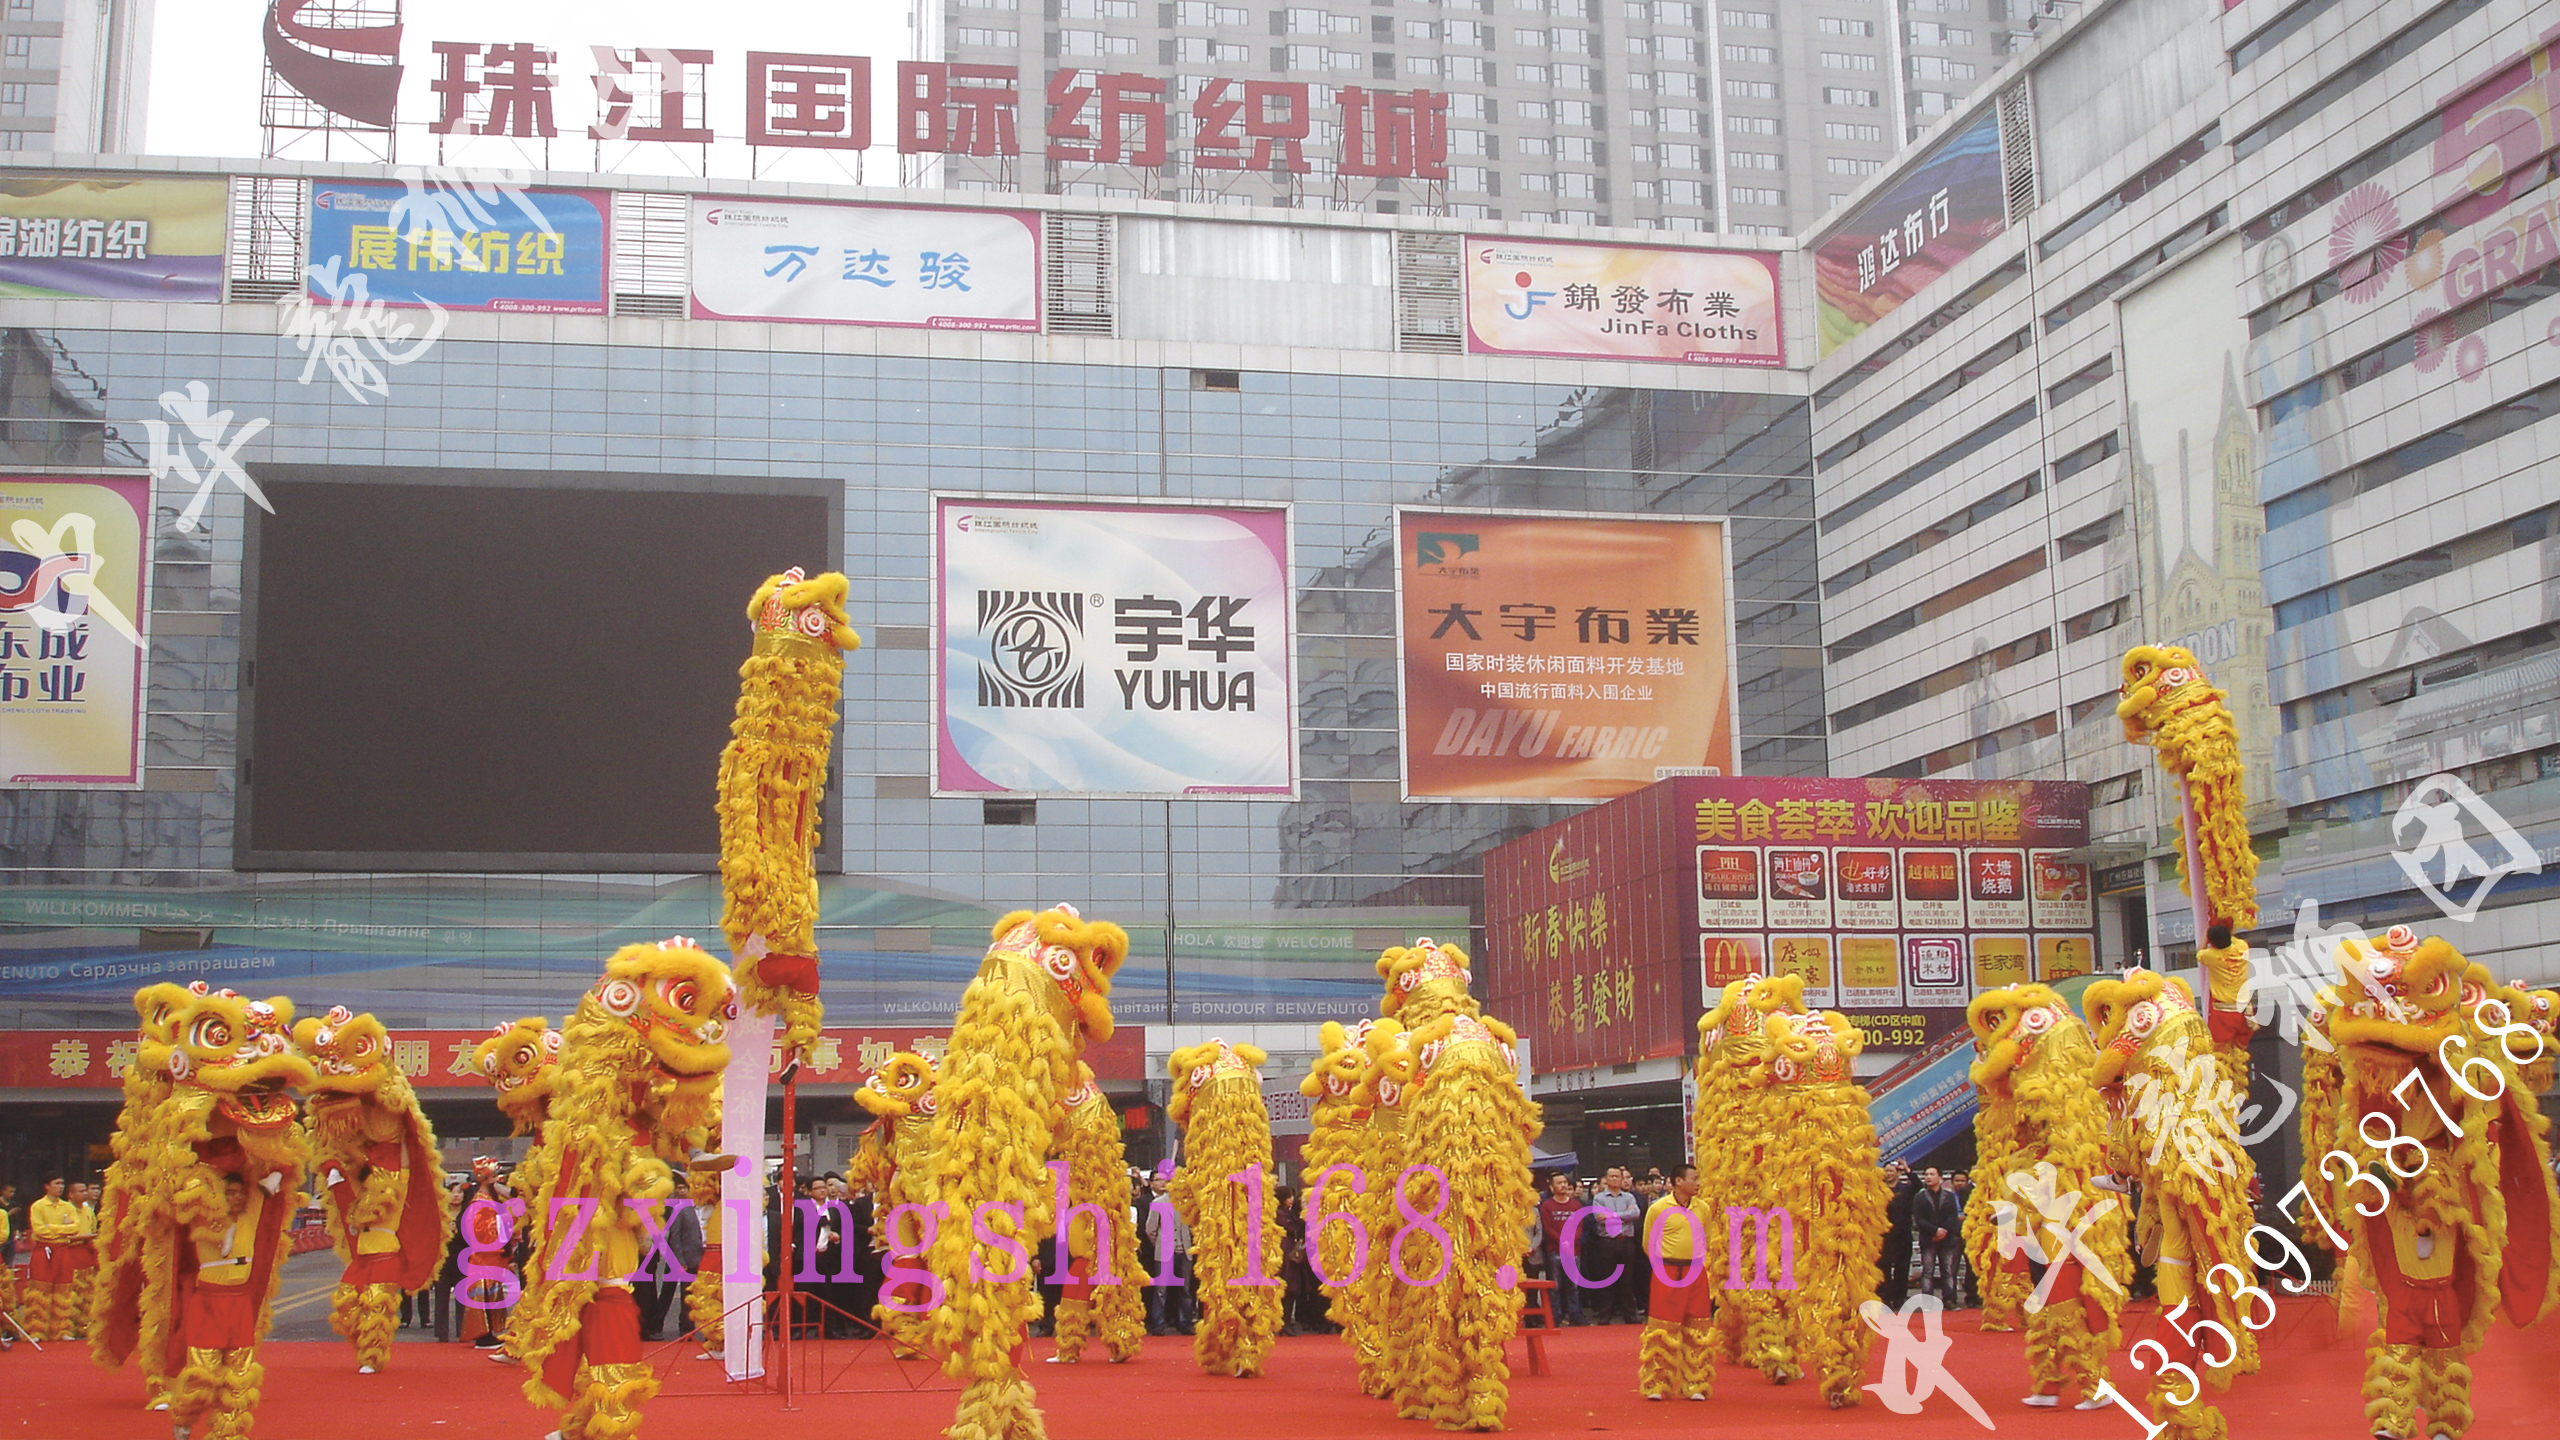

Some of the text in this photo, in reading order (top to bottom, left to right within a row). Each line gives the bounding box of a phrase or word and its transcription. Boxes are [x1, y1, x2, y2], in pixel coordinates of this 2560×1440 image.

[429, 39, 1448, 180] 珠江国际纺织城
[349, 224, 564, 276] 展伟纺织
[1857, 187, 1949, 294] 鸿达布行
[764, 245, 972, 292] 万达骏
[1562, 282, 1741, 319] 錦發布業
[1600, 319, 1759, 341] JinFa Cloths
[1114, 594, 1256, 663] 宇华
[1428, 602, 1700, 647] 大宇布業
[1445, 652, 1685, 678] 国家时装休闲面料开发基地
[0, 664, 86, 703] 布业
[1114, 668, 1255, 712] YUHUA
[1480, 681, 1654, 702] 中国流行面料入围企业
[1433, 708, 1670, 760] DAYU FABRIC
[1695, 798, 2021, 843] 美食荟萃 欢迎品鉴
[1981, 859, 2012, 876] 大塘
[24, 901, 157, 917] WILLKOMMEN
[1174, 932, 1215, 947] HOLA
[1276, 936, 1353, 949] WELCOME
[0, 965, 60, 980] ENUTO
[70, 956, 275, 980] Сардэчна запрашаем
[1979, 954, 2025, 971] 毛家湾
[1111, 1001, 1179, 1015] ывітанне
[1192, 1002, 1369, 1015] BONJOUR BENVENUTO
